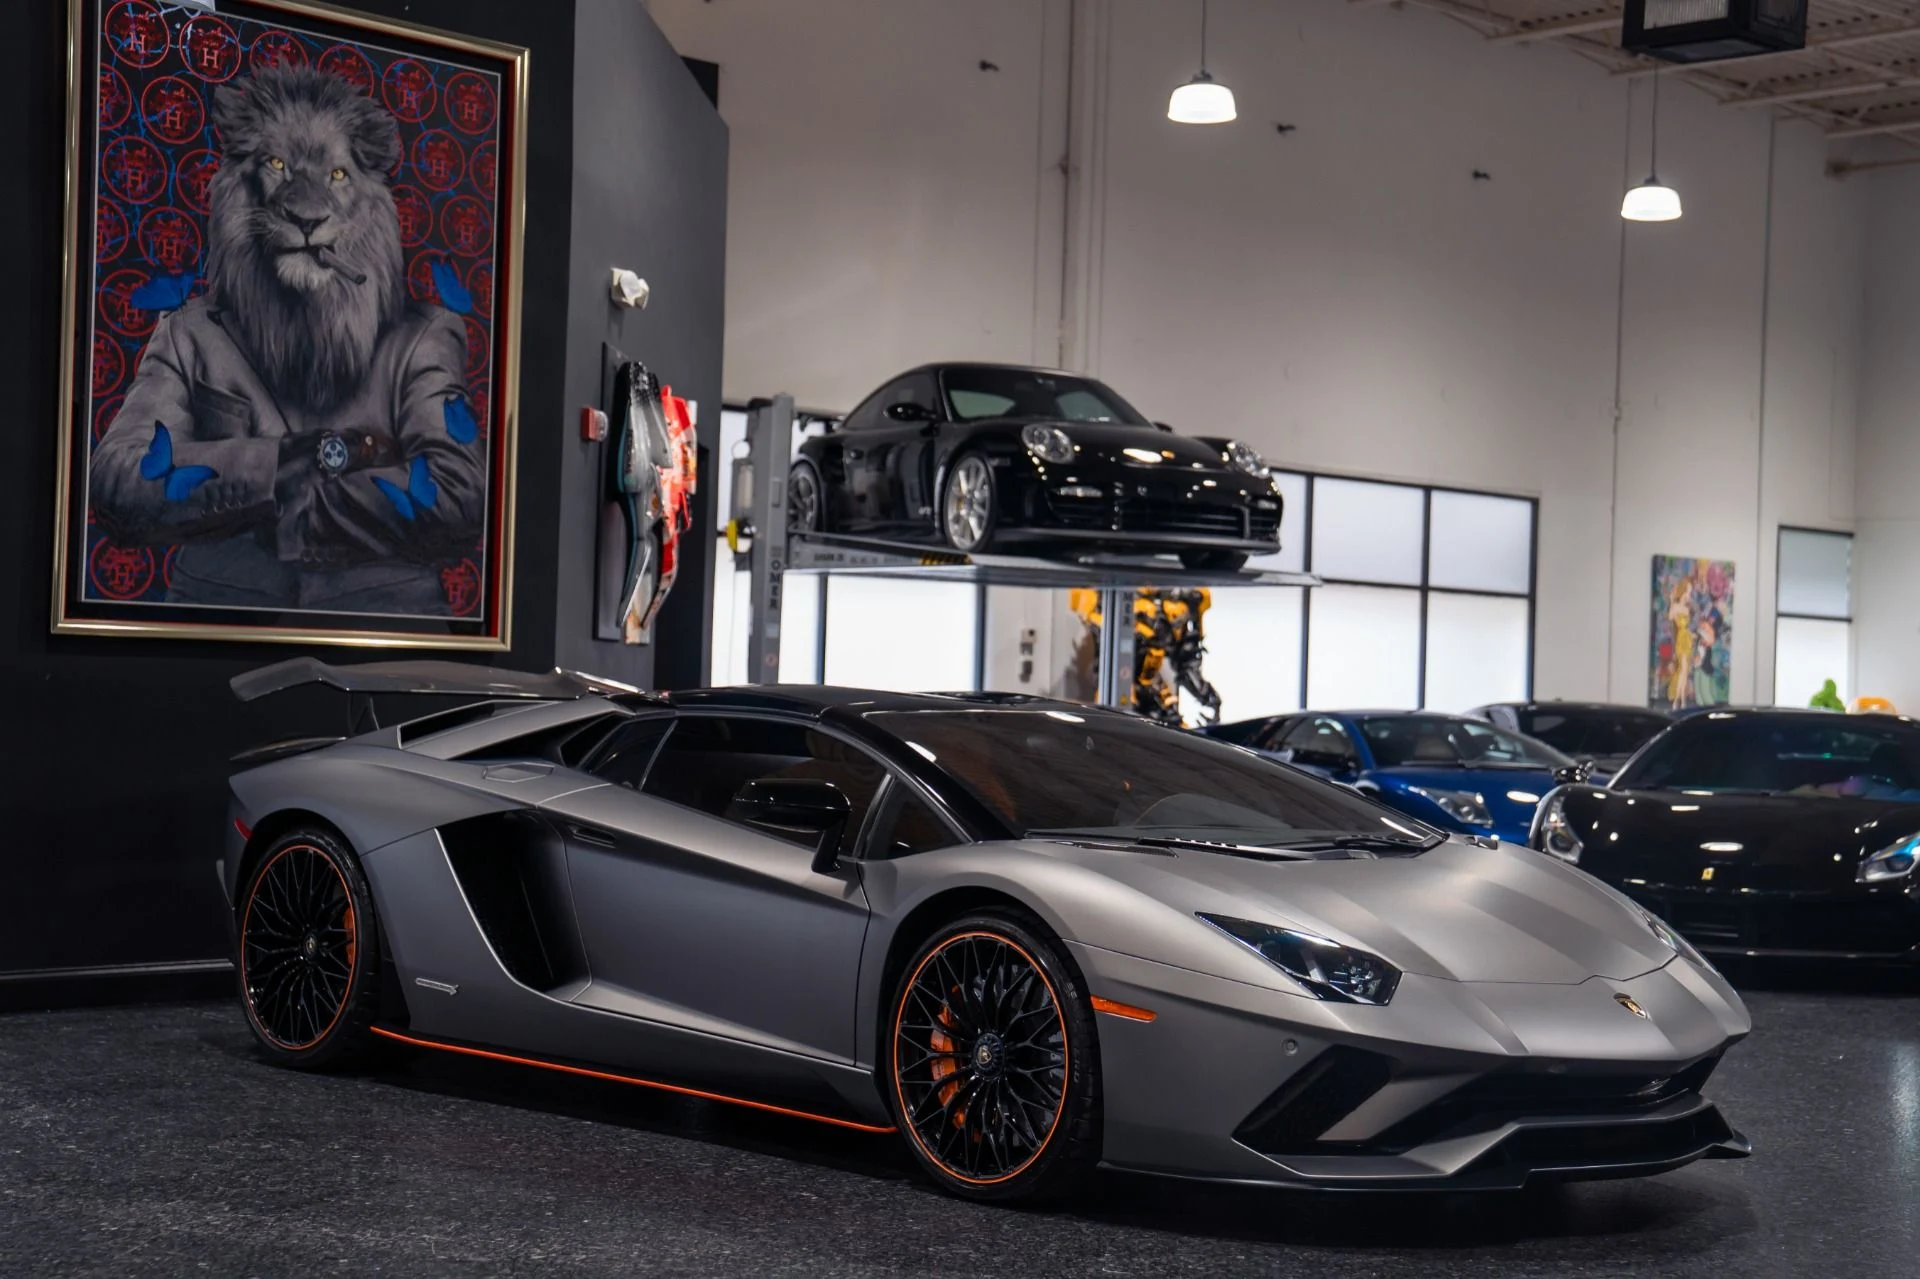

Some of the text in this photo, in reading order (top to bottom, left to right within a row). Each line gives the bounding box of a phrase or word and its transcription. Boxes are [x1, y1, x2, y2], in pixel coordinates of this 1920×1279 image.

[129, 32, 146, 53] H
[202, 47, 220, 69] H
[165, 110, 183, 130] H
[463, 102, 479, 121] H
[161, 238, 179, 258] H
